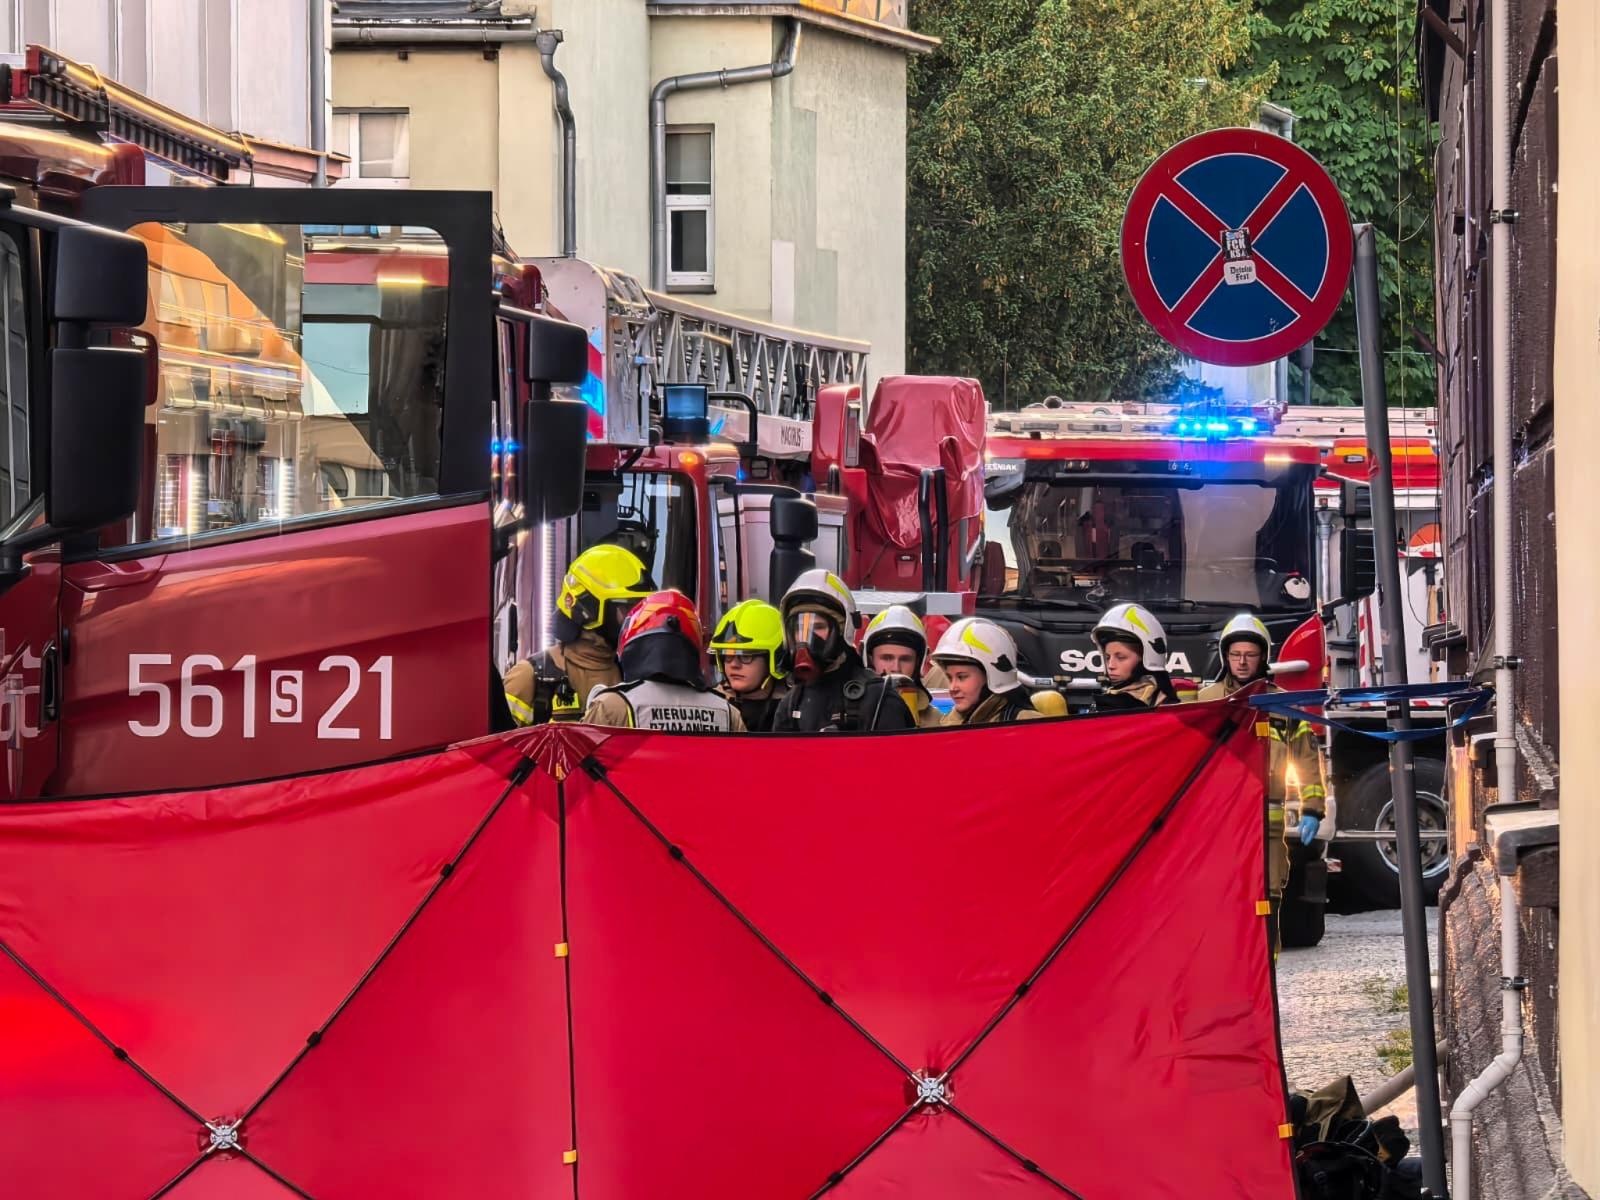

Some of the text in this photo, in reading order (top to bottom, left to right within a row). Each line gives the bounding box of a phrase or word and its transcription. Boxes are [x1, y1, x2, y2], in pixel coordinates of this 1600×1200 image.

[1060, 649, 1192, 673] SCA
[128, 653, 256, 738] 561
[317, 655, 393, 740] 21
